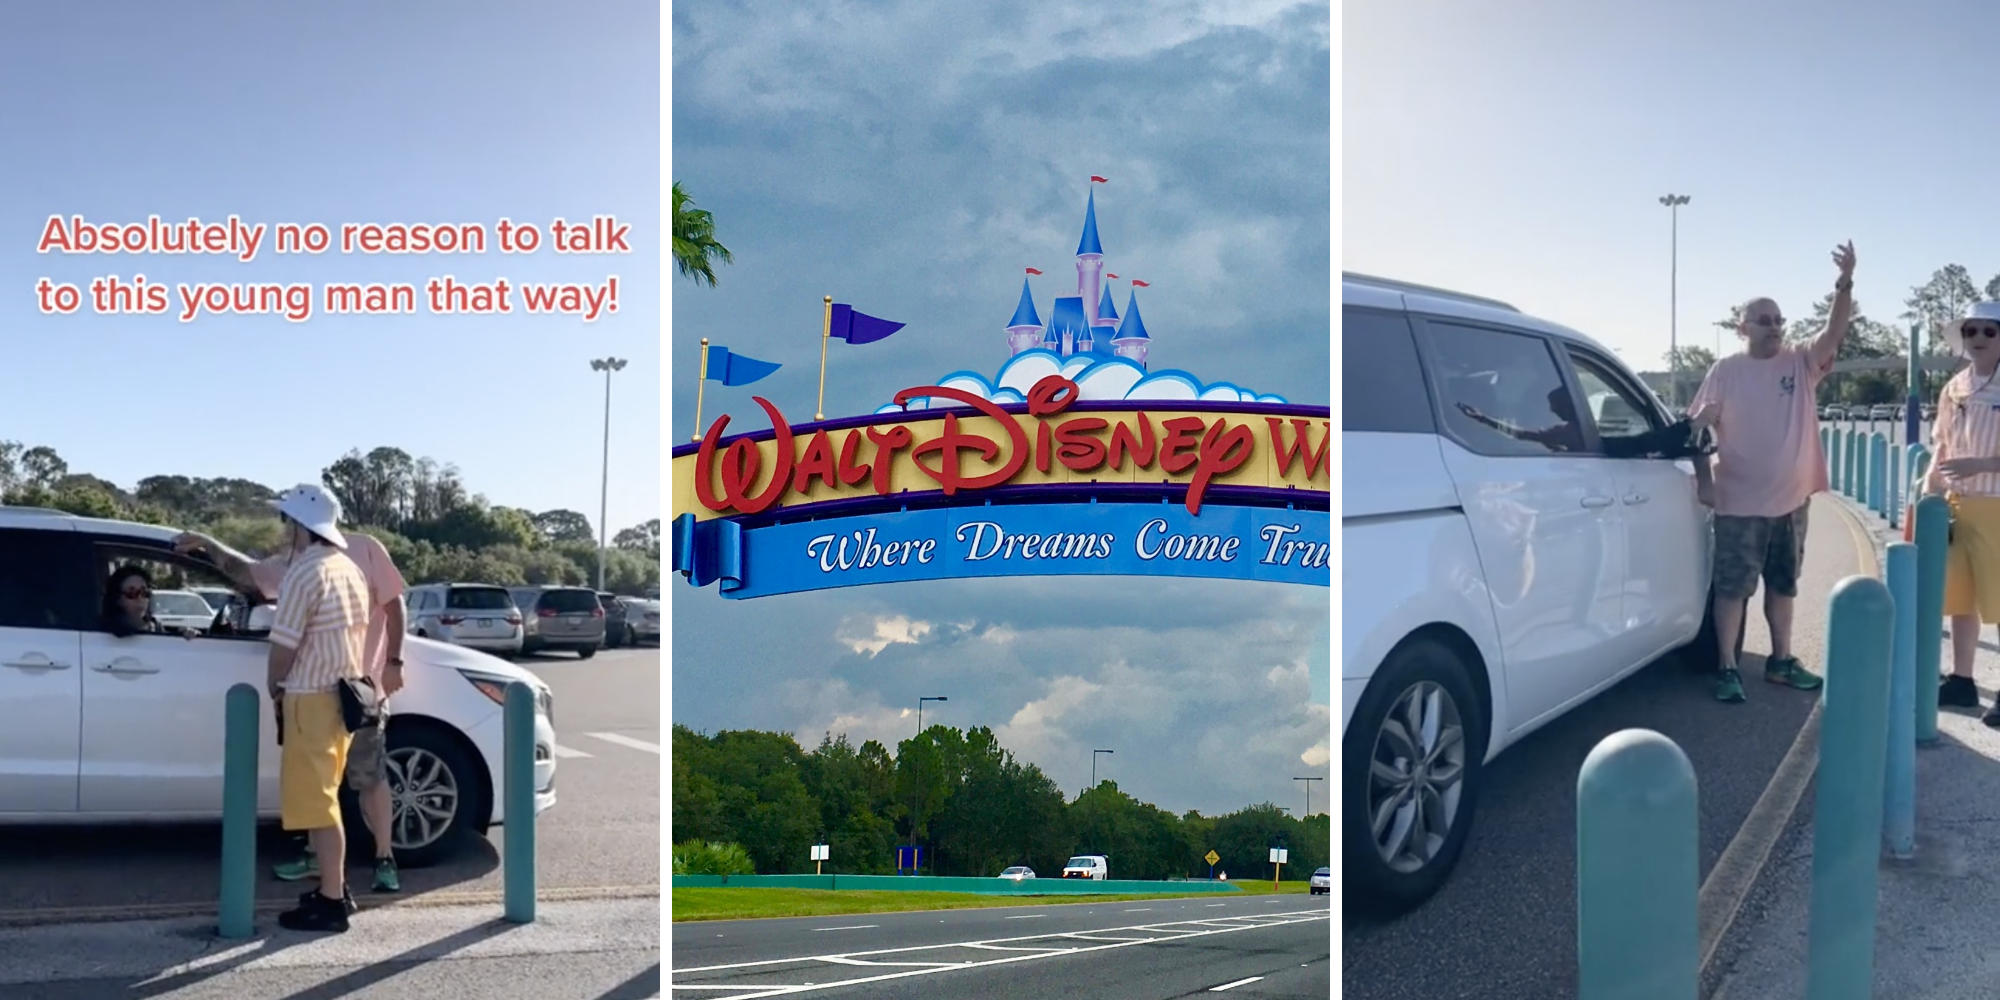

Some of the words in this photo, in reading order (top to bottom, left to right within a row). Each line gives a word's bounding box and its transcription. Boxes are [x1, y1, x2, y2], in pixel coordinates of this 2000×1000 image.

[1265, 417, 1330, 481] W
[806, 526, 937, 573] Where
[955, 521, 1115, 562] Dreams
[1135, 518, 1241, 562] Come
[1259, 523, 1330, 569] Tru
